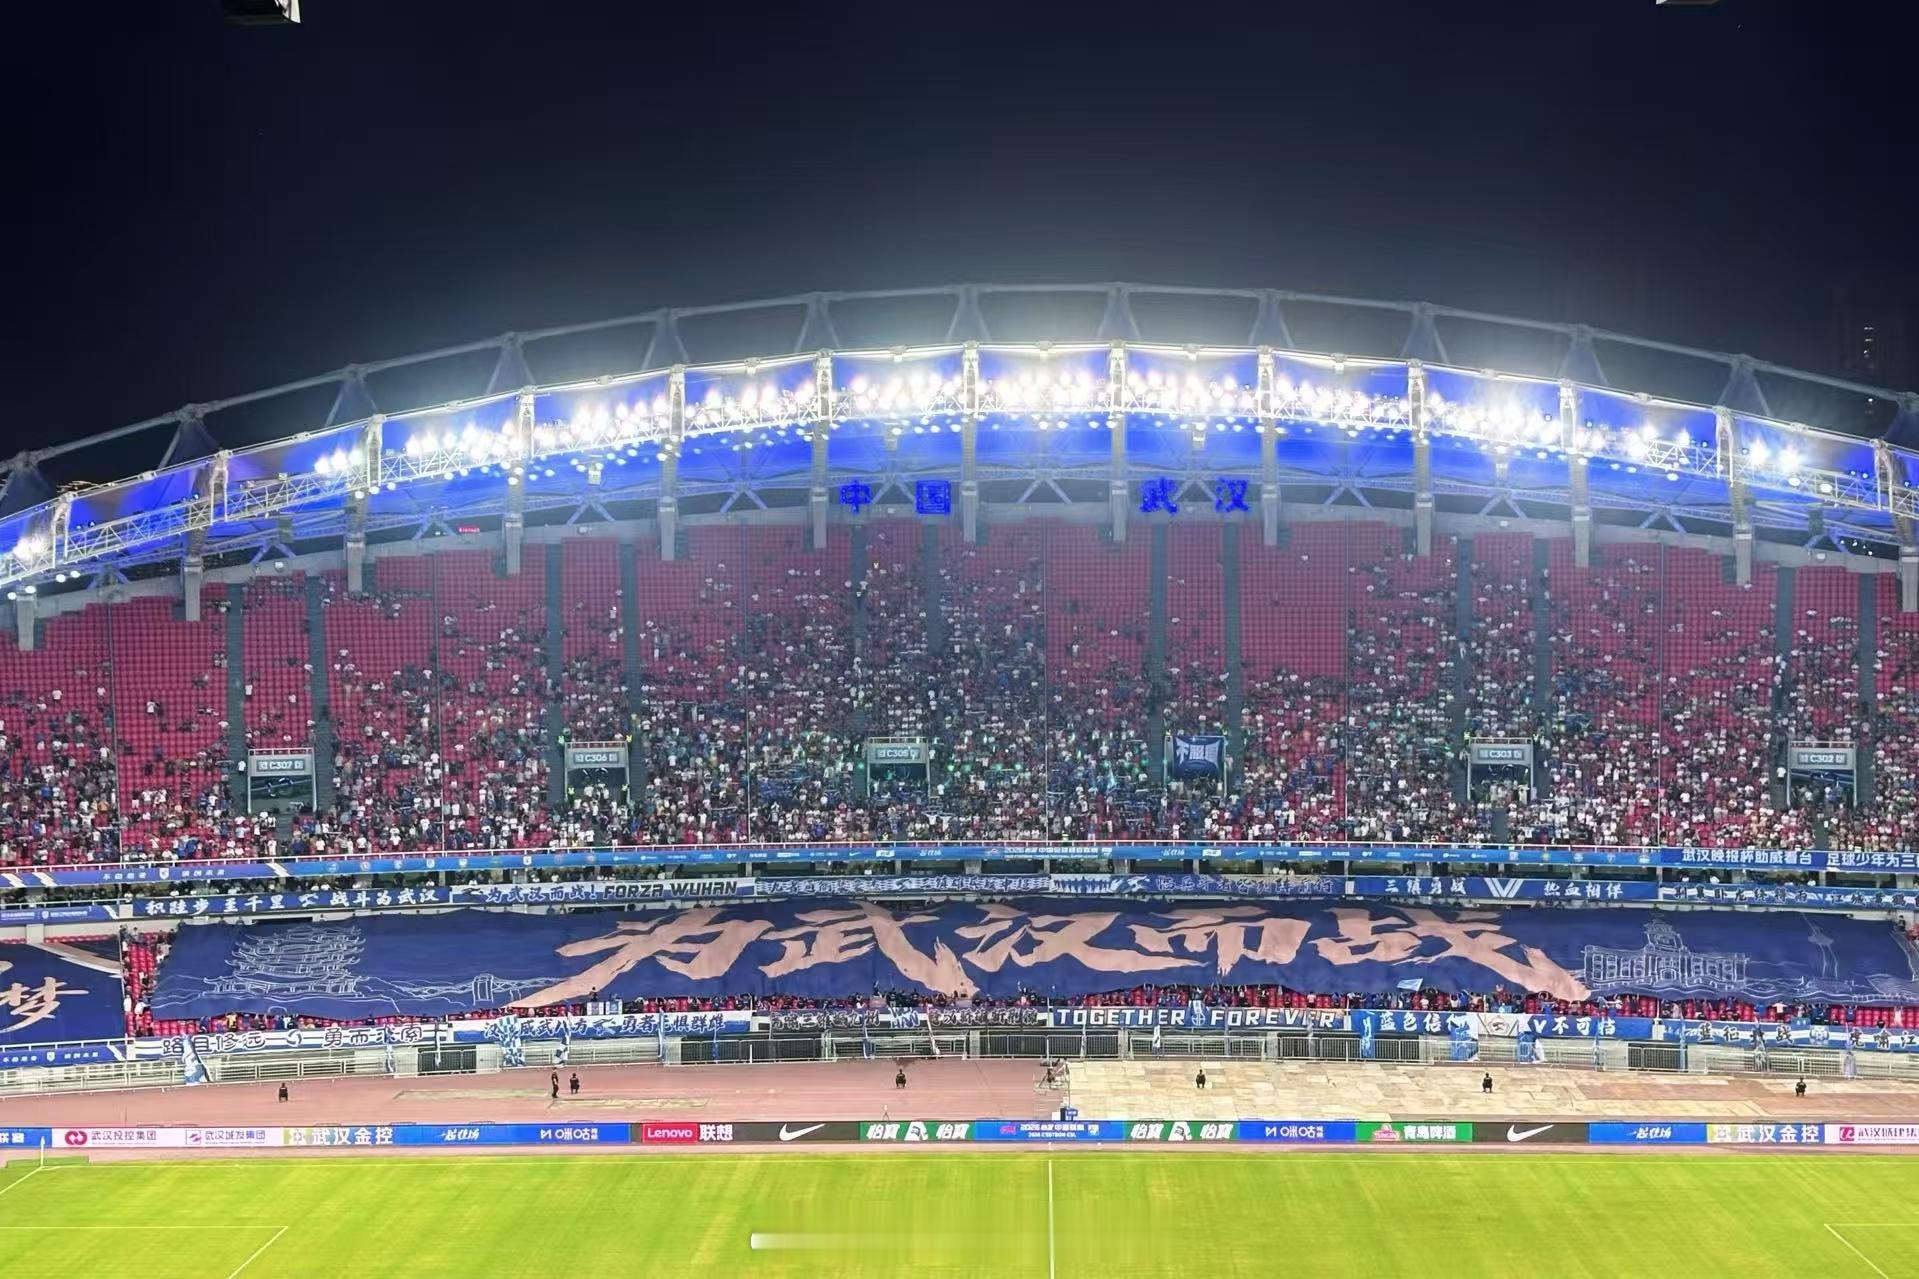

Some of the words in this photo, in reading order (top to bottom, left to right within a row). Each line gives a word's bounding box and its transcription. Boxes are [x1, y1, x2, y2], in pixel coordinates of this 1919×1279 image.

[840, 479, 951, 515] 中国
[1139, 476, 1252, 514] 武汉
[1682, 849, 1812, 864] 武汉晚报杯助威看台
[1827, 852, 1919, 868] 足球少年为三
[603, 884, 664, 899] FORZA
[669, 881, 737, 896] WUHAN
[1057, 1008, 1185, 1027] TOGETHER
[1211, 1009, 1336, 1028] FOREVER
[91, 1130, 157, 1142] 武汉投控集团
[311, 1128, 393, 1145] 武汉金控
[647, 1127, 693, 1138] Lenovo
[699, 1124, 733, 1141] 联想
[1737, 1125, 1819, 1142] 武汉金控
